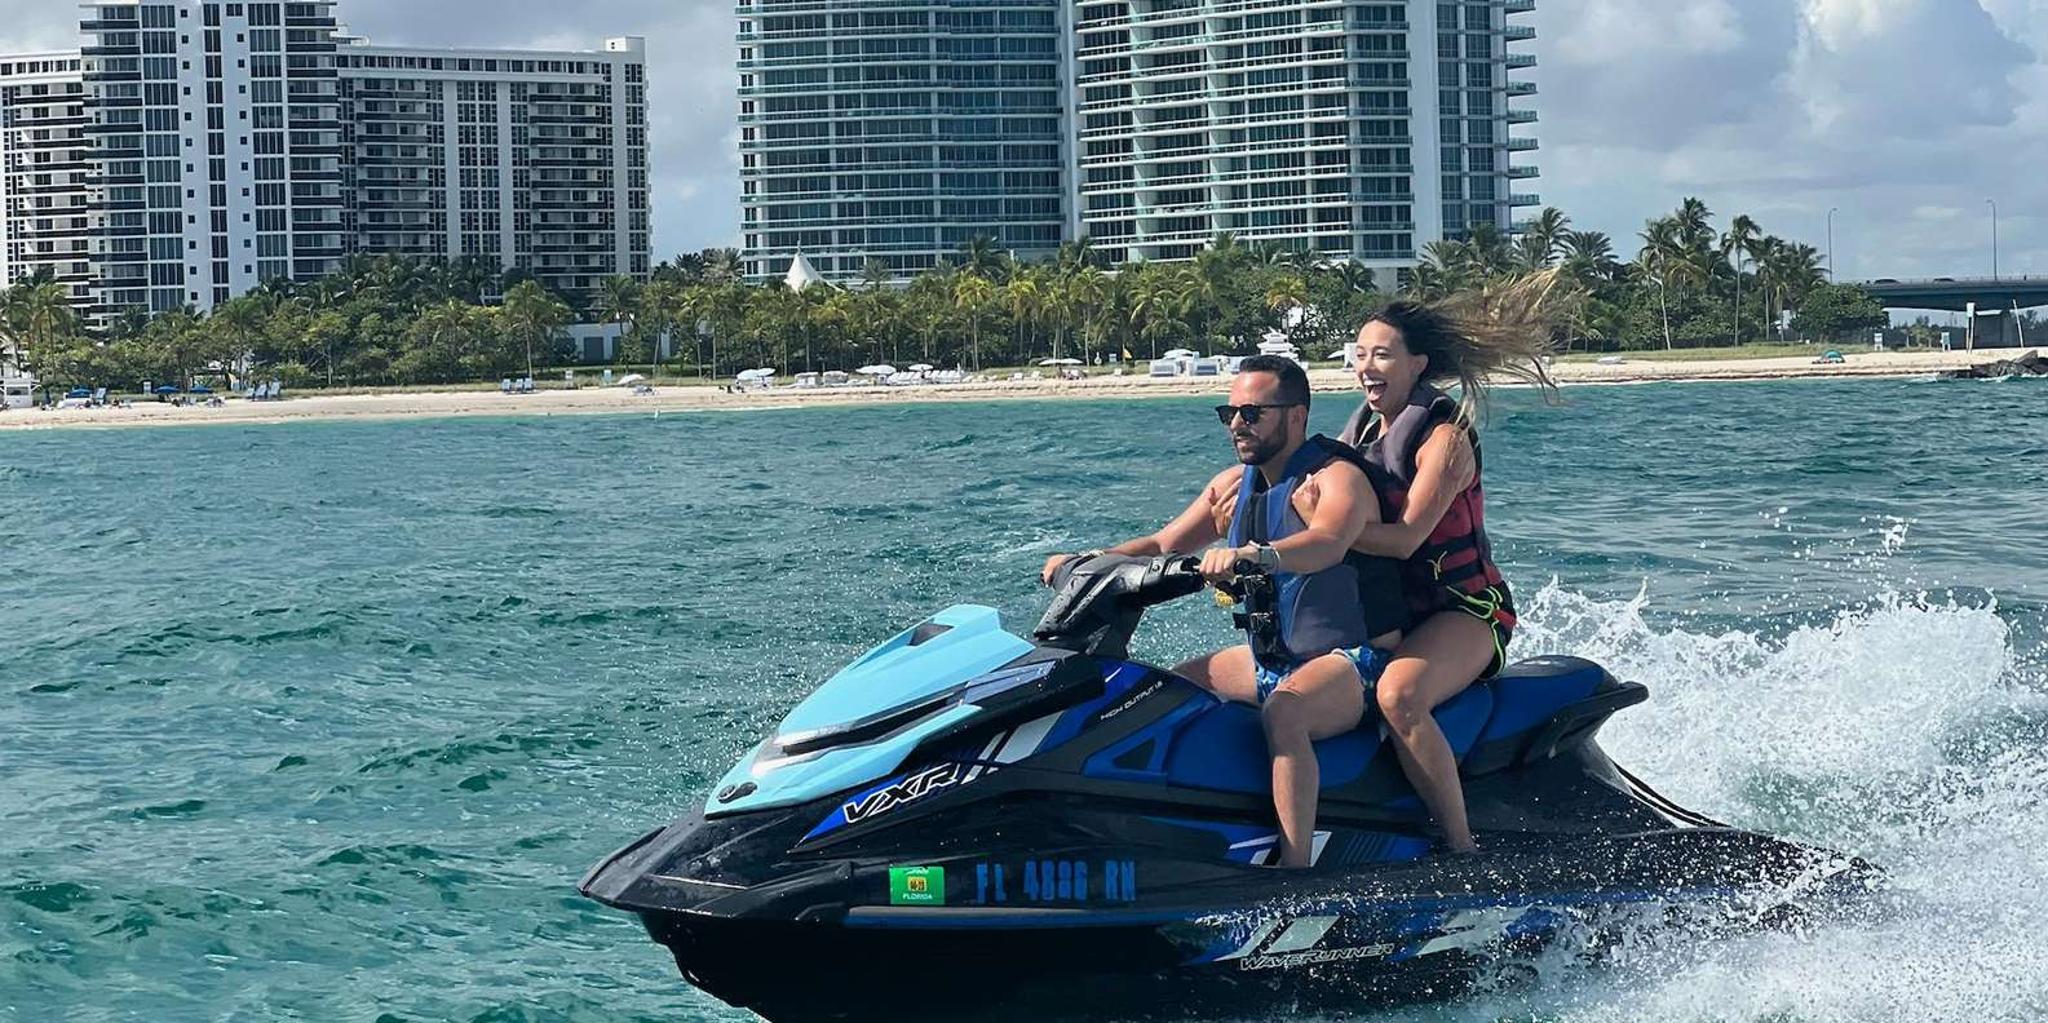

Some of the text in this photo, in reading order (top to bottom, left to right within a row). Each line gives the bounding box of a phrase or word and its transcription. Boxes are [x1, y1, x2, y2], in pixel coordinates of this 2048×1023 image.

[843, 762, 958, 823] VXR
[976, 862, 1007, 903] FL
[1105, 860, 1136, 902] RN
[1240, 943, 1394, 971] WAVERUNNER
